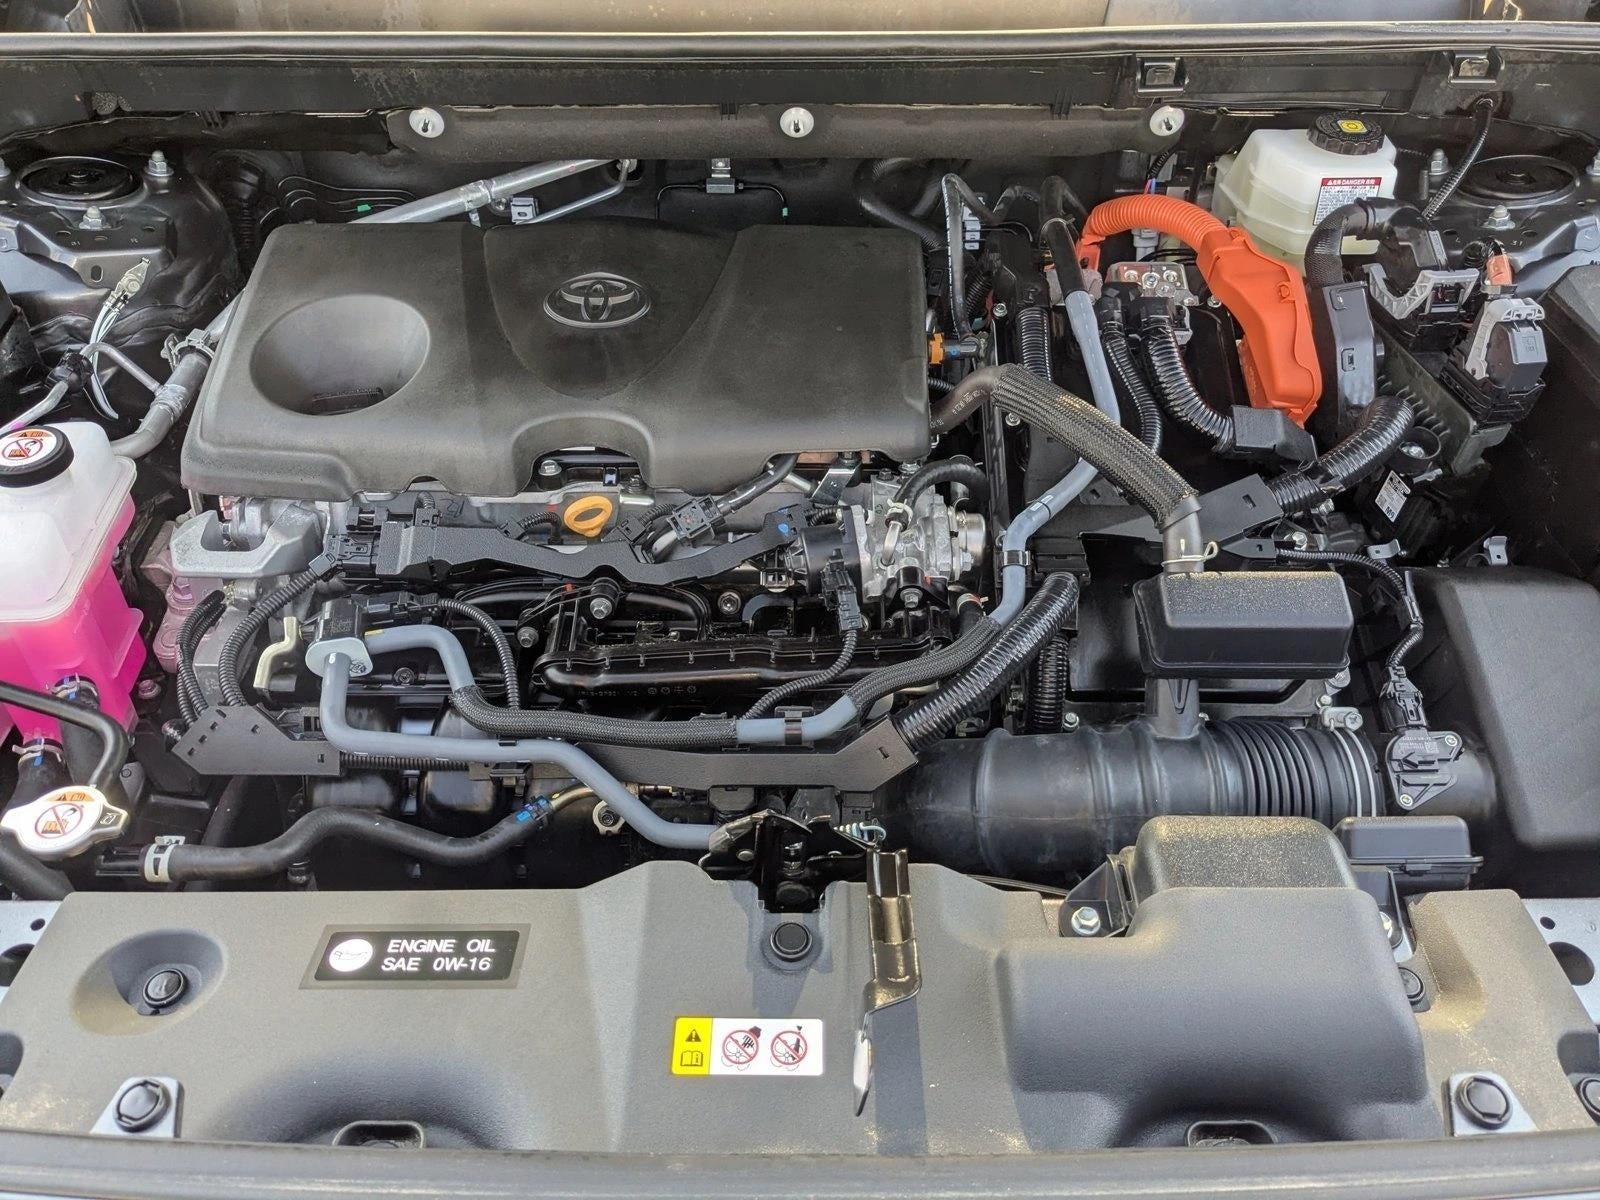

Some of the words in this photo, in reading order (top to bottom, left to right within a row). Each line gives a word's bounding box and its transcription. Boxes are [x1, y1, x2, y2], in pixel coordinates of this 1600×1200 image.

[387, 938, 456, 953] ENGINE
[466, 938, 496, 953] OIL
[381, 957, 421, 971] SAE
[432, 957, 492, 971] 0W-16
